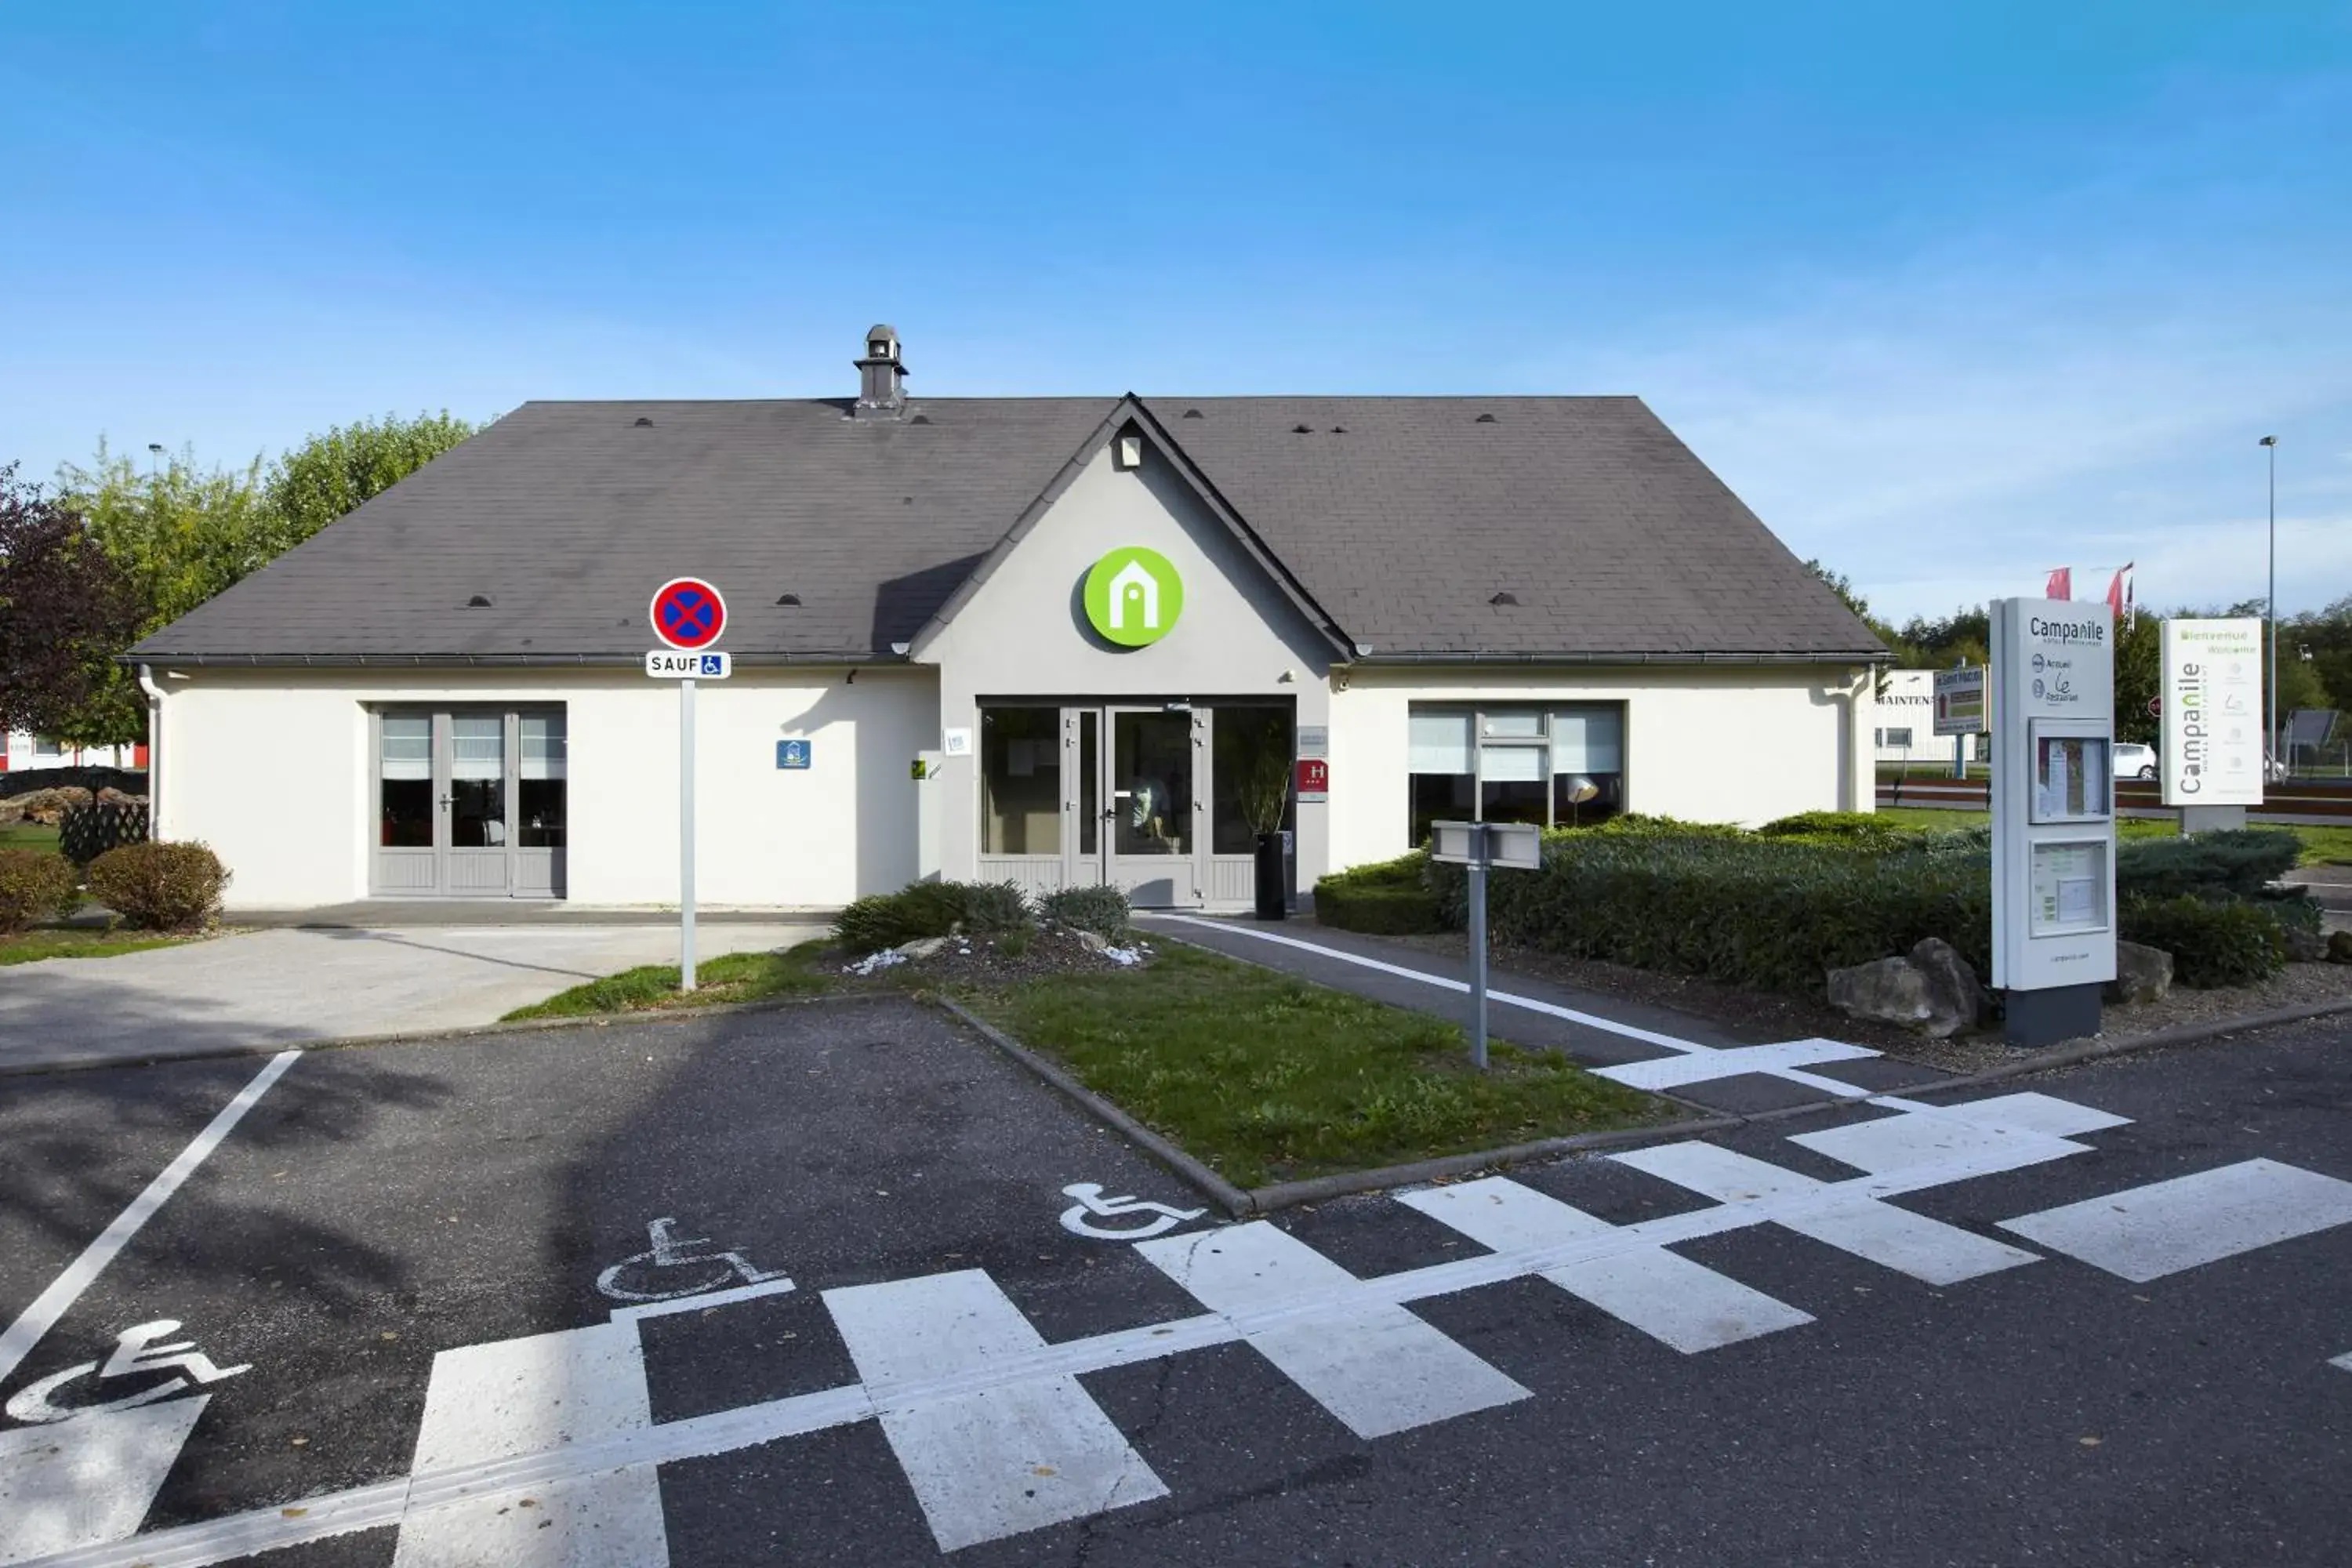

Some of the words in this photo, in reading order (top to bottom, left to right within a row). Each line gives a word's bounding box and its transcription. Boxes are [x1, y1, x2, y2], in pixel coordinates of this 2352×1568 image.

[2031, 617, 2103, 644] Campanile
[652, 657, 698, 671] SAUF
[2178, 663, 2208, 793] Campanile
